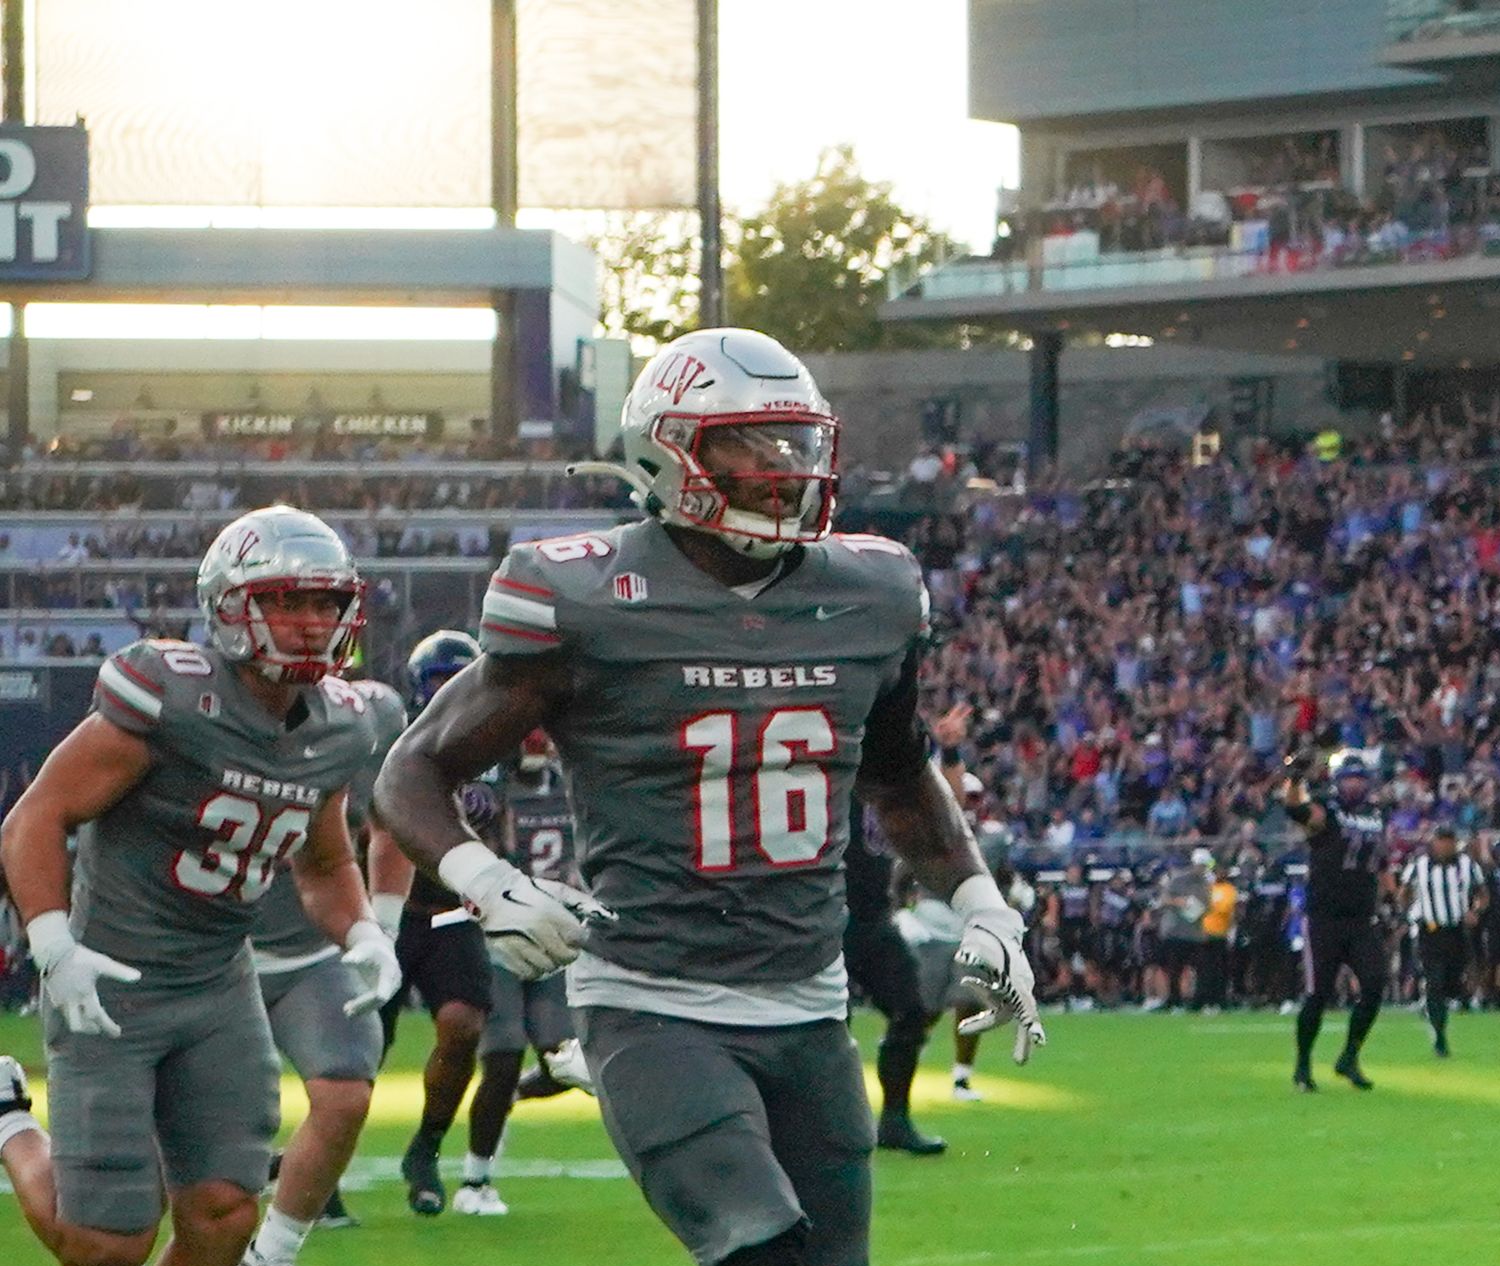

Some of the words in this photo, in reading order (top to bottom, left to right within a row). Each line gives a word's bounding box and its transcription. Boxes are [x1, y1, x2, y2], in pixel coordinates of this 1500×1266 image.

[333, 414, 427, 436] CHICKEN
[682, 664, 837, 688] REBELS
[679, 704, 838, 873] 16
[170, 790, 311, 901] 30
[530, 829, 564, 878] 2
